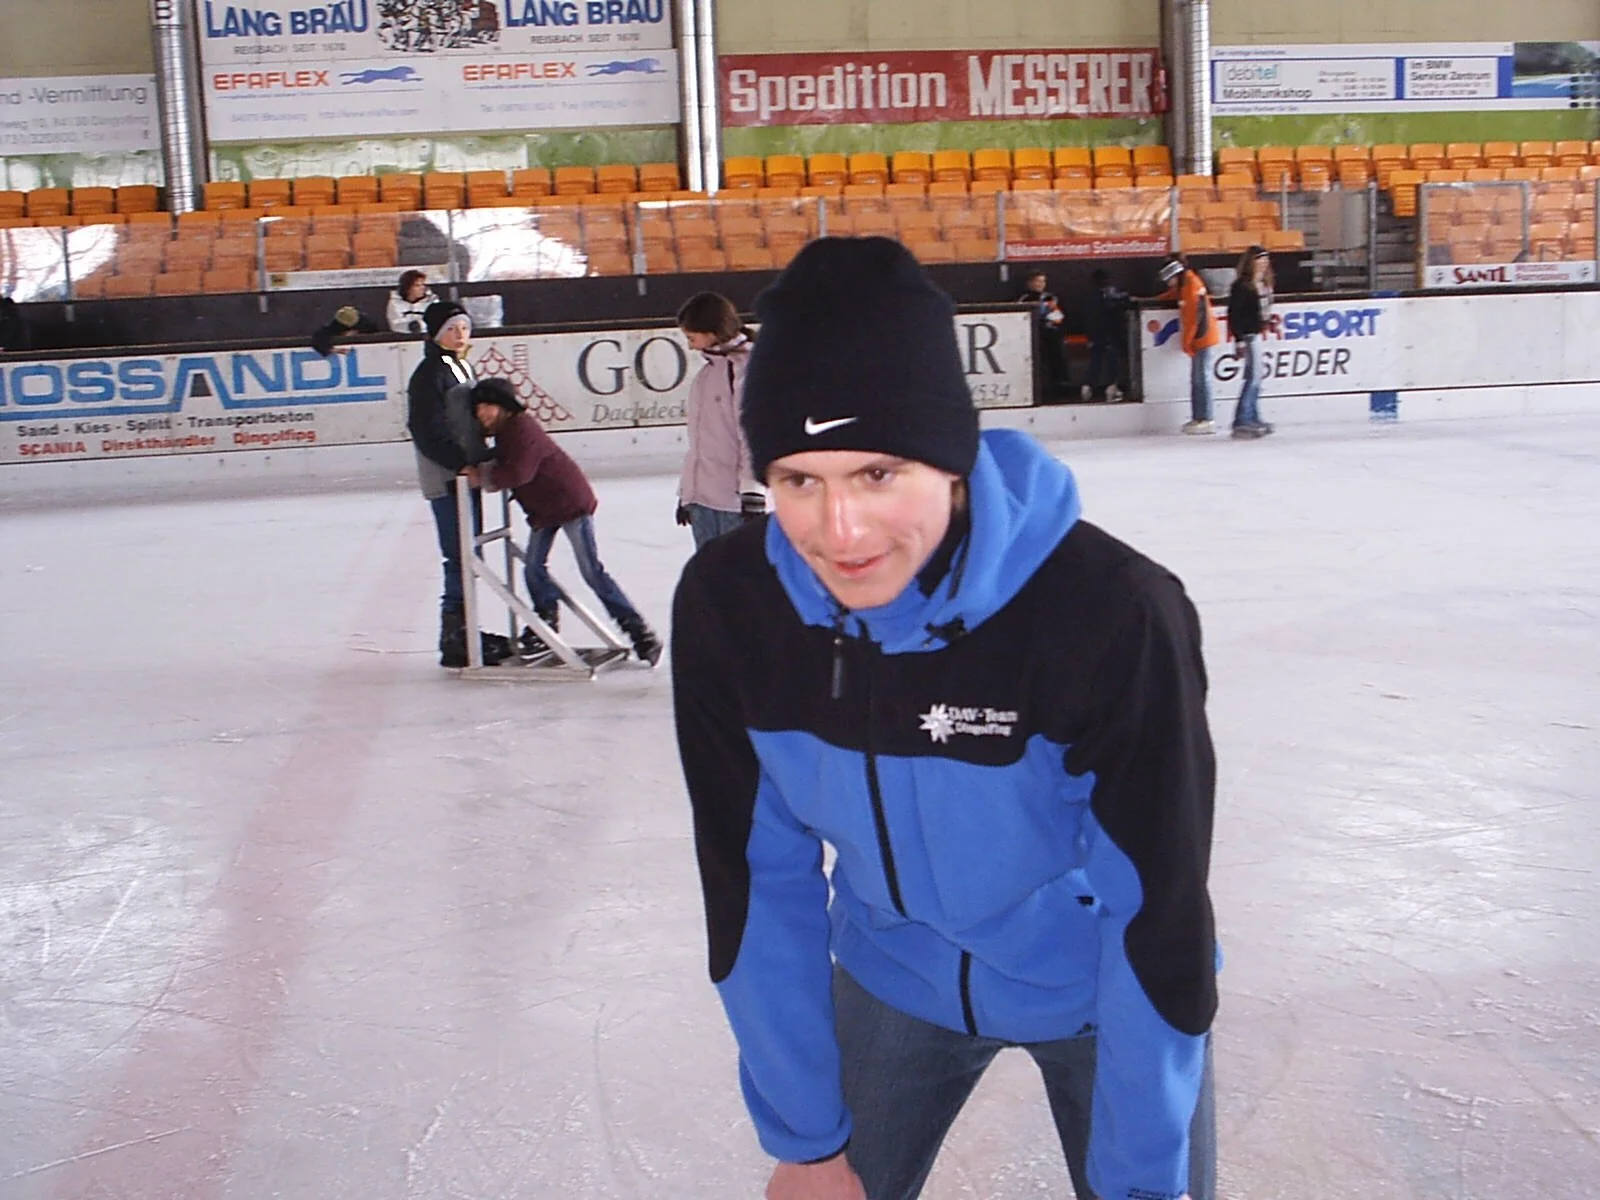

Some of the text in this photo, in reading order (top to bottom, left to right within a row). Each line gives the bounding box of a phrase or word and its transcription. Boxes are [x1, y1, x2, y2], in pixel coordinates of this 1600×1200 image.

[205, 0, 367, 38] LANG BRÄU
[505, 0, 579, 27] LANG
[462, 62, 576, 81] EFAFLEX
[1227, 64, 1278, 81] debitel
[1411, 71, 1491, 81] Service Zentrum
[1426, 60, 1452, 69] BMW
[213, 71, 330, 91] EFAFLEX
[729, 53, 1153, 119] Spedition MESSERER
[1223, 87, 1313, 100] Mobilfunkshop
[958, 322, 1007, 375] R
[0, 346, 387, 410] OSSANDL
[577, 336, 687, 396] GO
[17, 411, 315, 437] Sand Kies Splitt Transportbeton
[18, 441, 87, 456] SCANIA
[233, 428, 317, 445] Dingolfing
